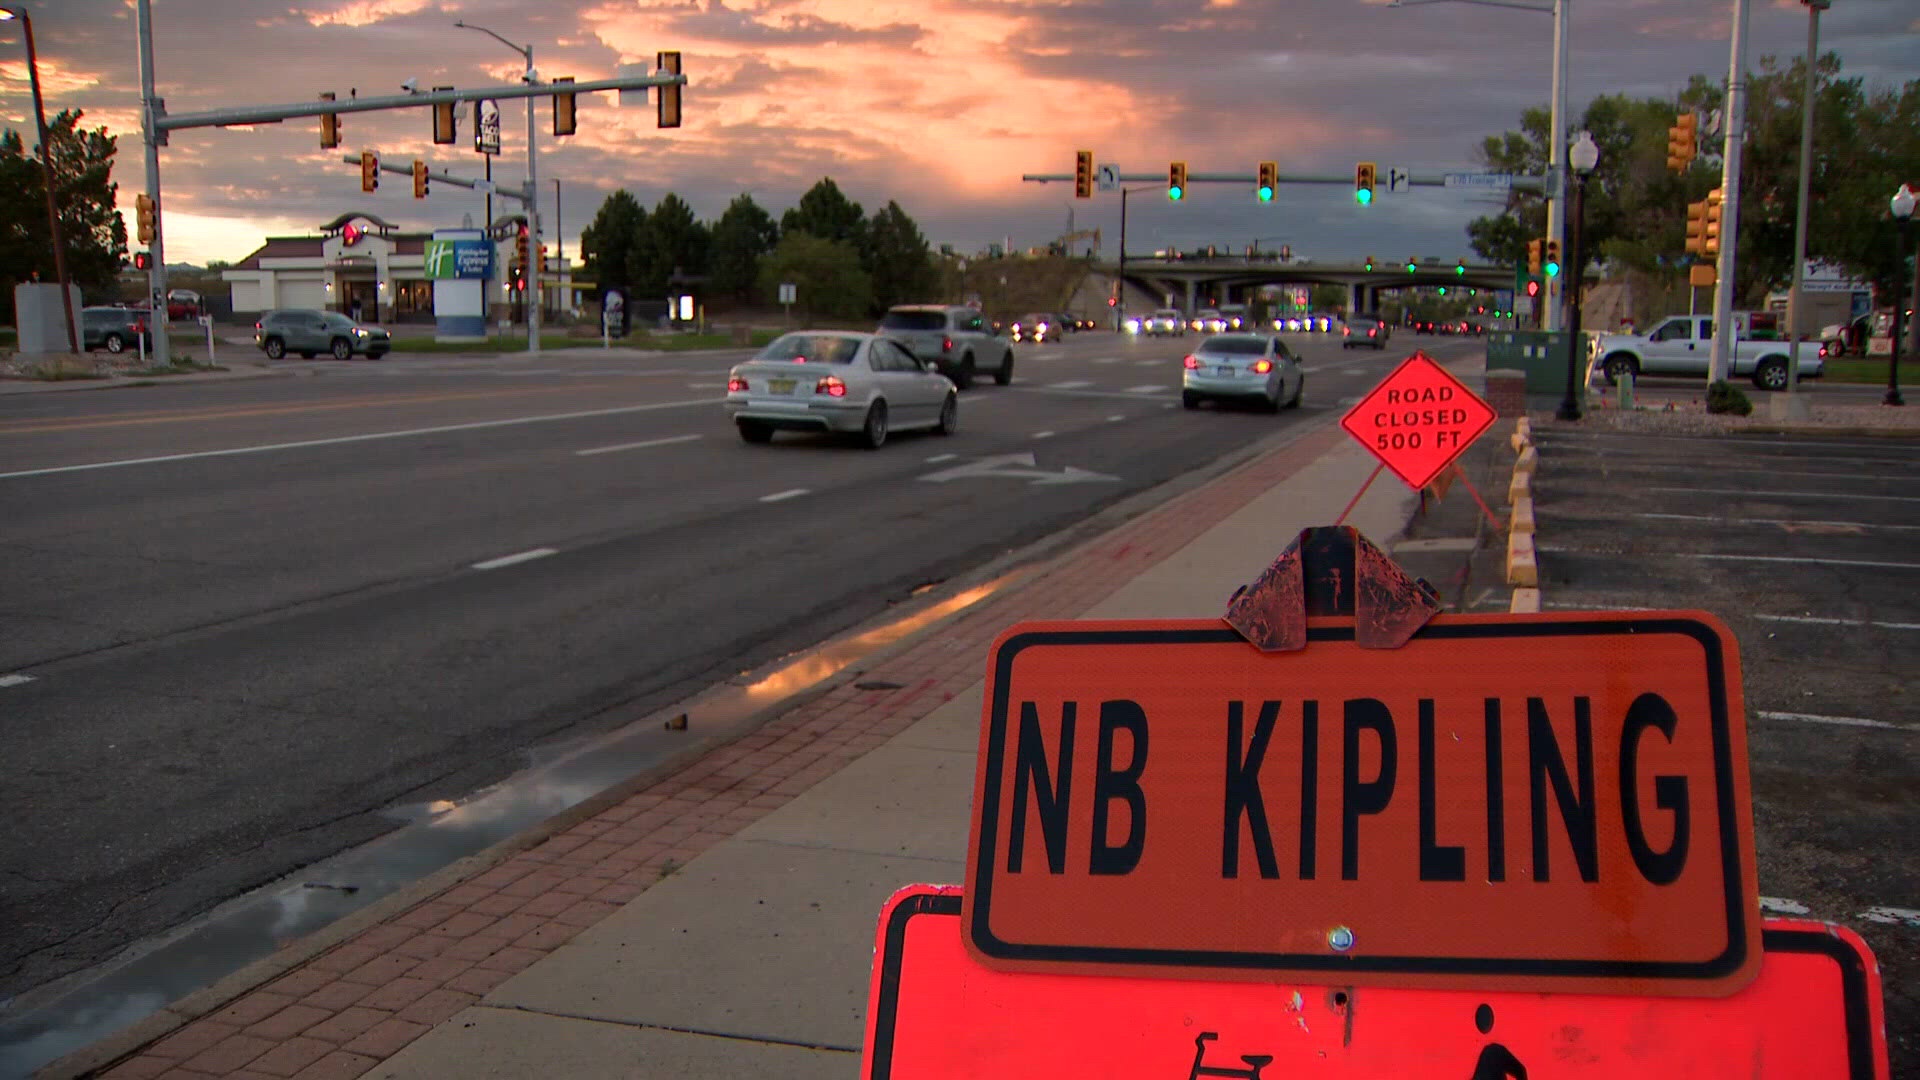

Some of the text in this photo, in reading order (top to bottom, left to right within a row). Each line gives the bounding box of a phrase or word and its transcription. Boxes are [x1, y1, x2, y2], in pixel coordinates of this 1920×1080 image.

[1388, 386, 1453, 404] ROAD
[1374, 408, 1467, 428] CLOSED
[1377, 430, 1461, 451] 500 FT
[1007, 691, 1691, 887] NB KIPLING
